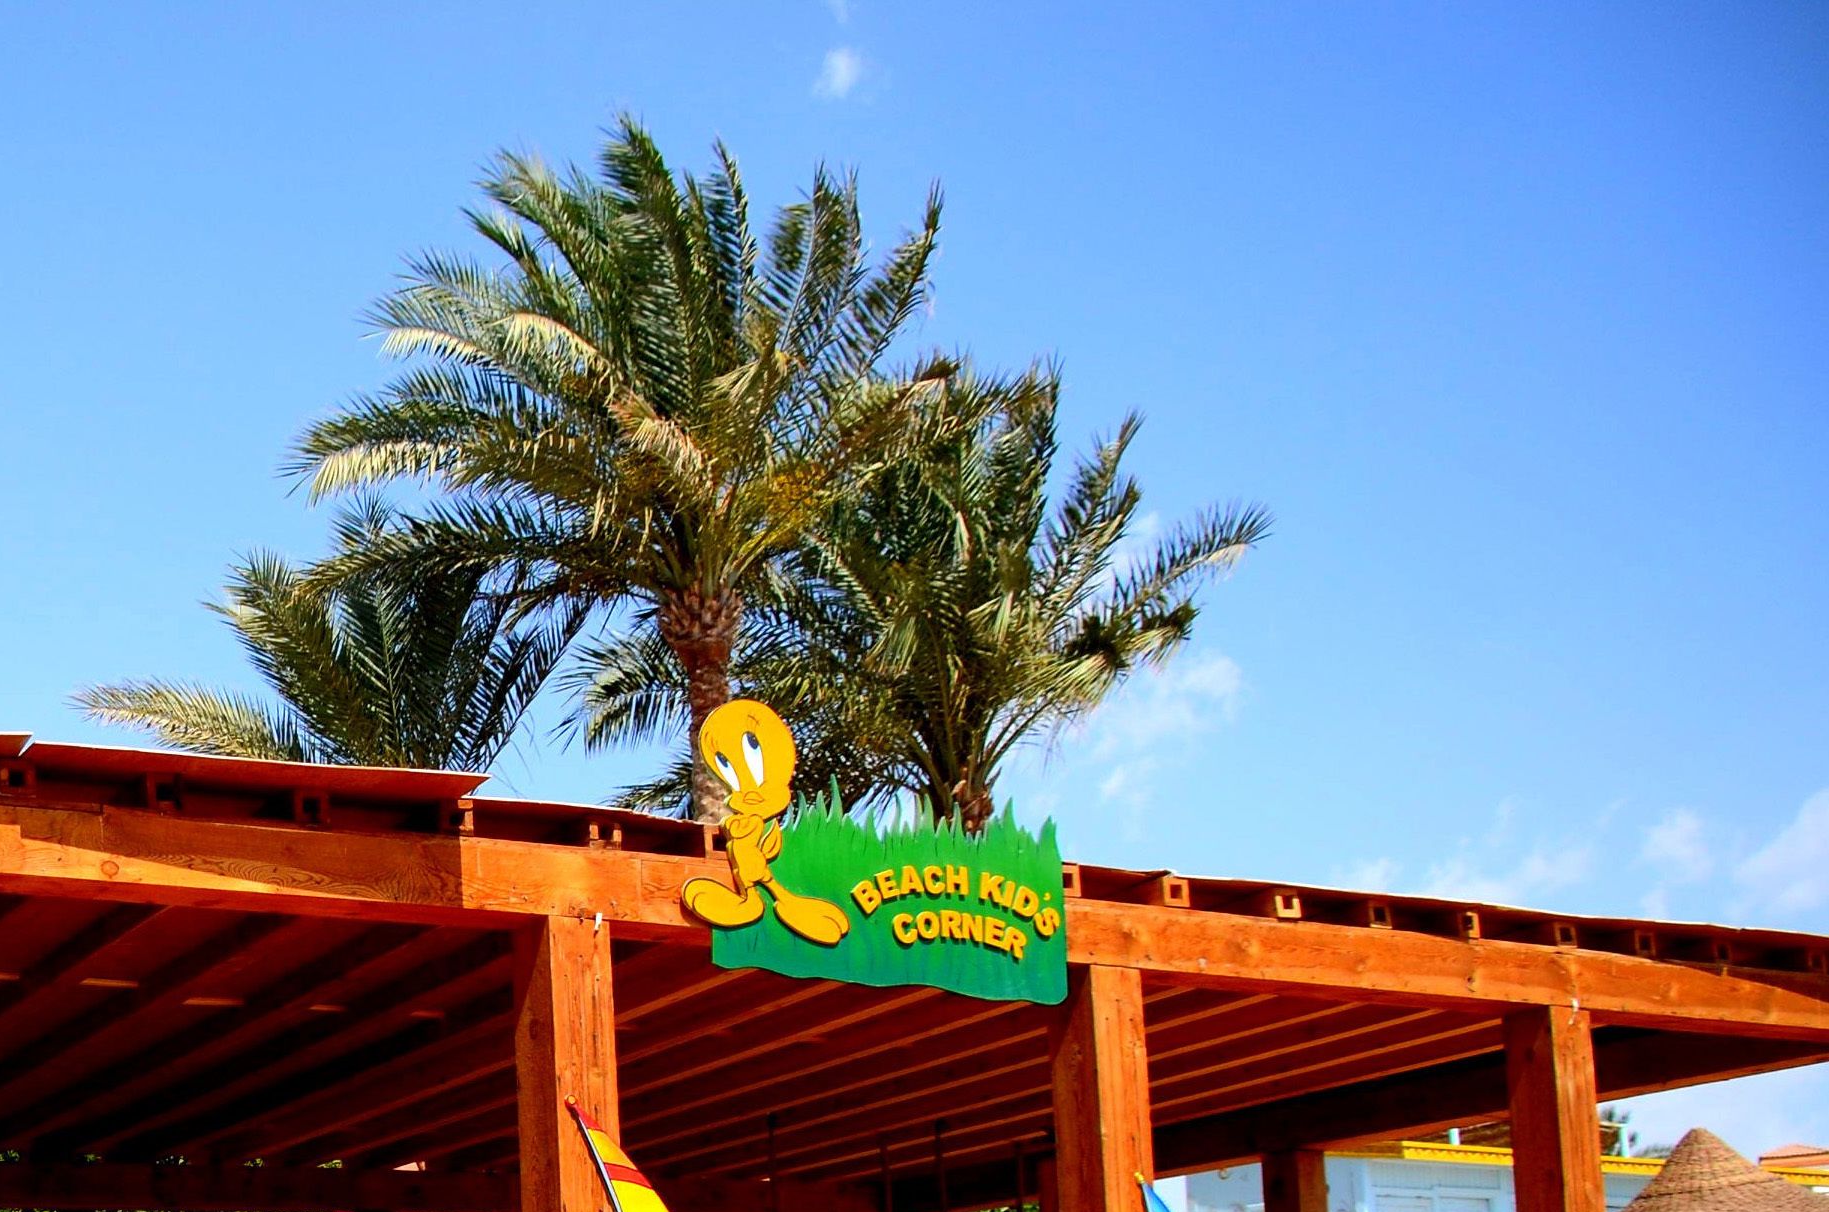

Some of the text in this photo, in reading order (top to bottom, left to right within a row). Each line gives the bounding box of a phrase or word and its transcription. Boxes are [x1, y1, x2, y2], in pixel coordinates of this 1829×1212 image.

[851, 864, 1061, 937] BEACH KID'S
[892, 909, 1028, 960] CORNER
